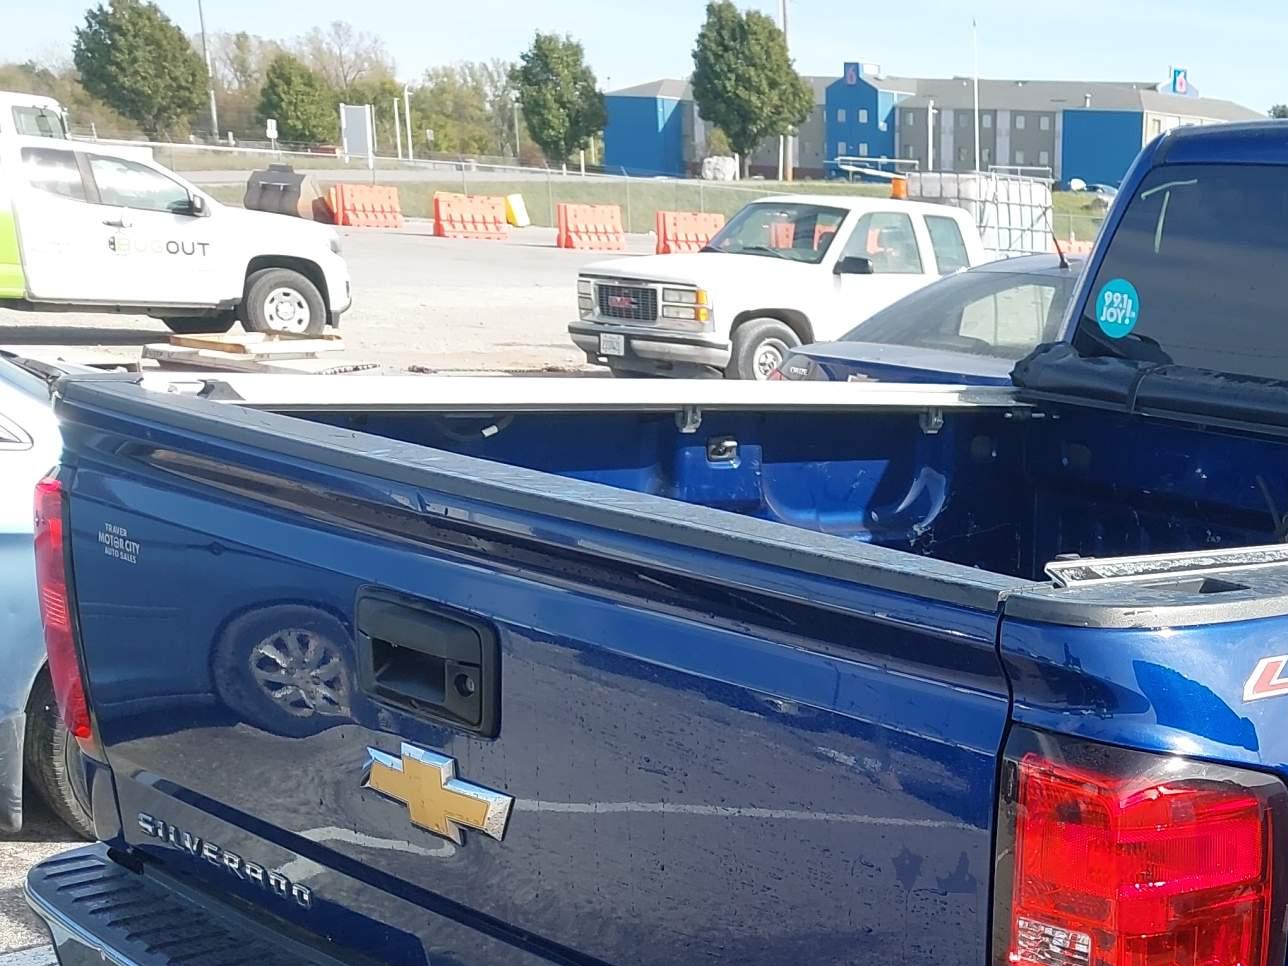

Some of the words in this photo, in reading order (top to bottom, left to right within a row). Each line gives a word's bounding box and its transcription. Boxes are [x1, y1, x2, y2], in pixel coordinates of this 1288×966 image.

[1104, 290, 1129, 309] 99.1
[98, 530, 125, 550] MOTOR
[125, 540, 140, 555] CITY
[104, 546, 120, 558] AUTO
[120, 551, 137, 564] SALES
[137, 812, 313, 910] SILVERADO
